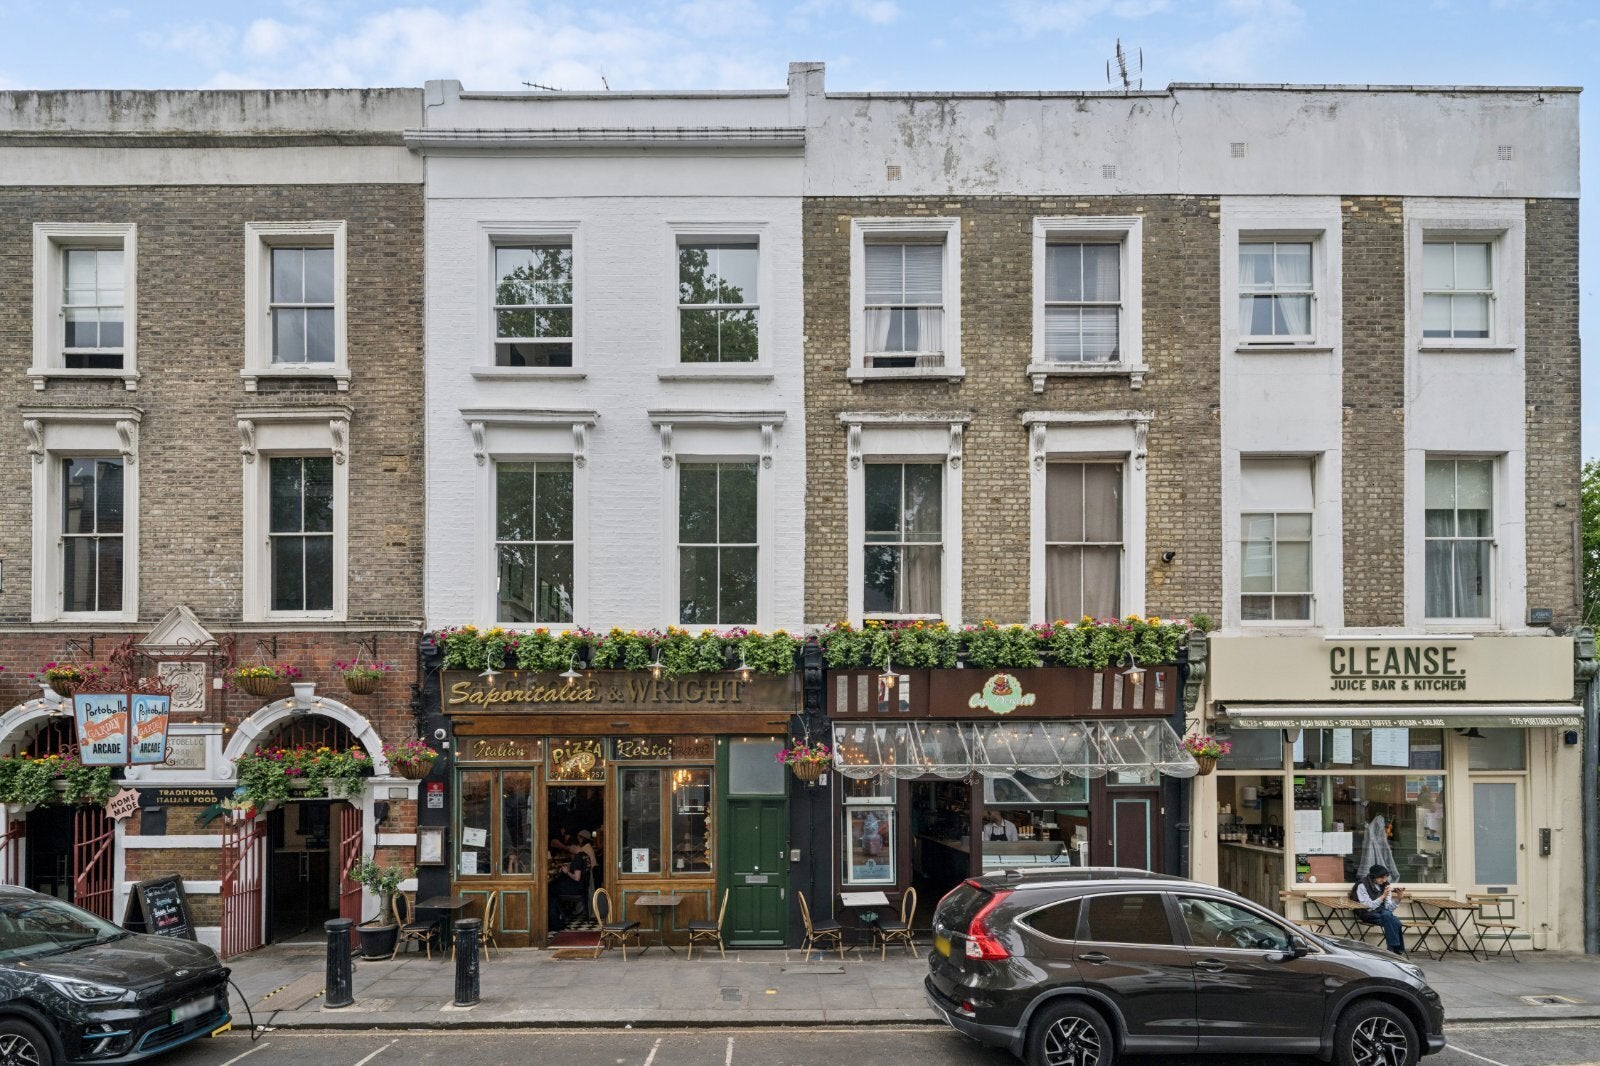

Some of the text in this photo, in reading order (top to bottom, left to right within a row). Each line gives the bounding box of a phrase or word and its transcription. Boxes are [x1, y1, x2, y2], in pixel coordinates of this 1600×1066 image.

[1330, 647, 1466, 675] CLEANSE.
[626, 679, 745, 704] WRIGHT
[1330, 680, 1466, 690] JUICE BAR & KITCHEN
[449, 681, 596, 709] Saporitalia
[86, 701, 128, 722] Portobello
[139, 702, 168, 722] Portobello
[87, 717, 120, 739] GARDEN
[1340, 719, 1371, 727] SPECIALIST
[1372, 719, 1392, 727] COFFEE
[1422, 718, 1445, 726] SALADS
[1524, 717, 1562, 726] PORTOBELLO
[1563, 717, 1580, 726] ROAD
[93, 743, 121, 754] ARCADE
[140, 743, 161, 753] ARCADE
[473, 740, 525, 758] Italian
[111, 794, 135, 810] HOME
[113, 801, 137, 817] MADE
